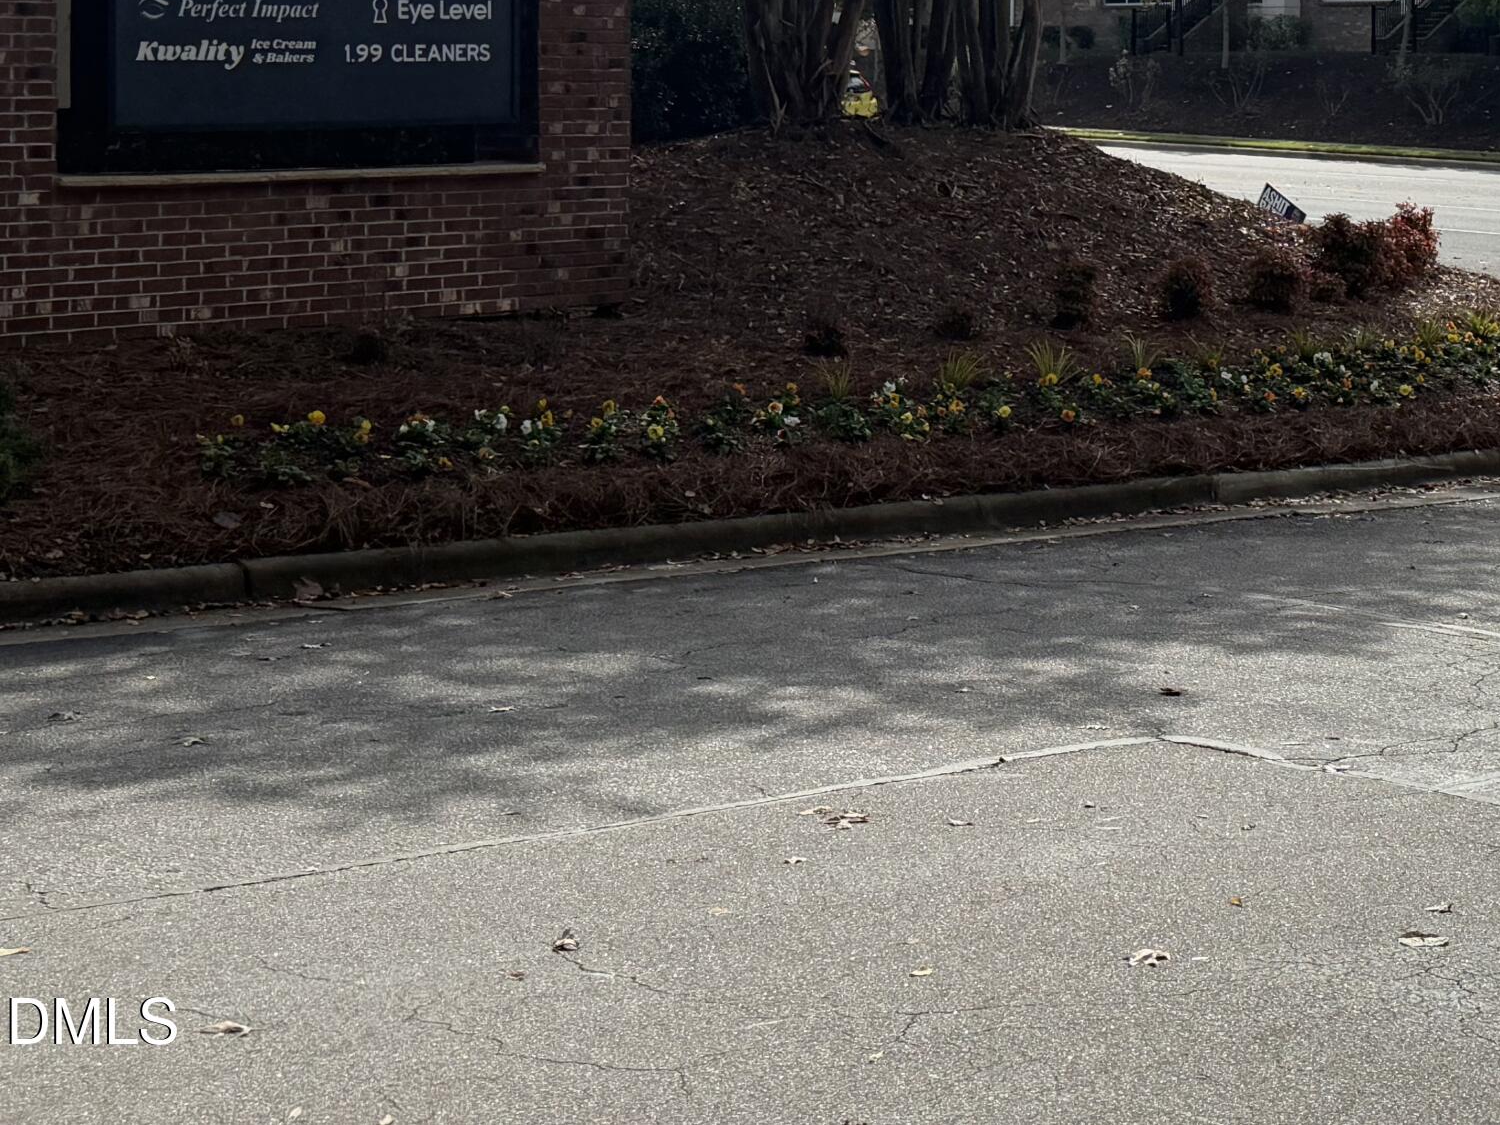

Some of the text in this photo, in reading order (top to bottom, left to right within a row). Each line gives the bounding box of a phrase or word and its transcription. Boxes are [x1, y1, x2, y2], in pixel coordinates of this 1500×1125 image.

[397, 0, 492, 24] Eye Level
[250, 38, 317, 50] Ice Cream
[344, 43, 491, 63] 1.99 CLEANERS
[135, 39, 245, 70] Kwality
[252, 52, 265, 65] &
